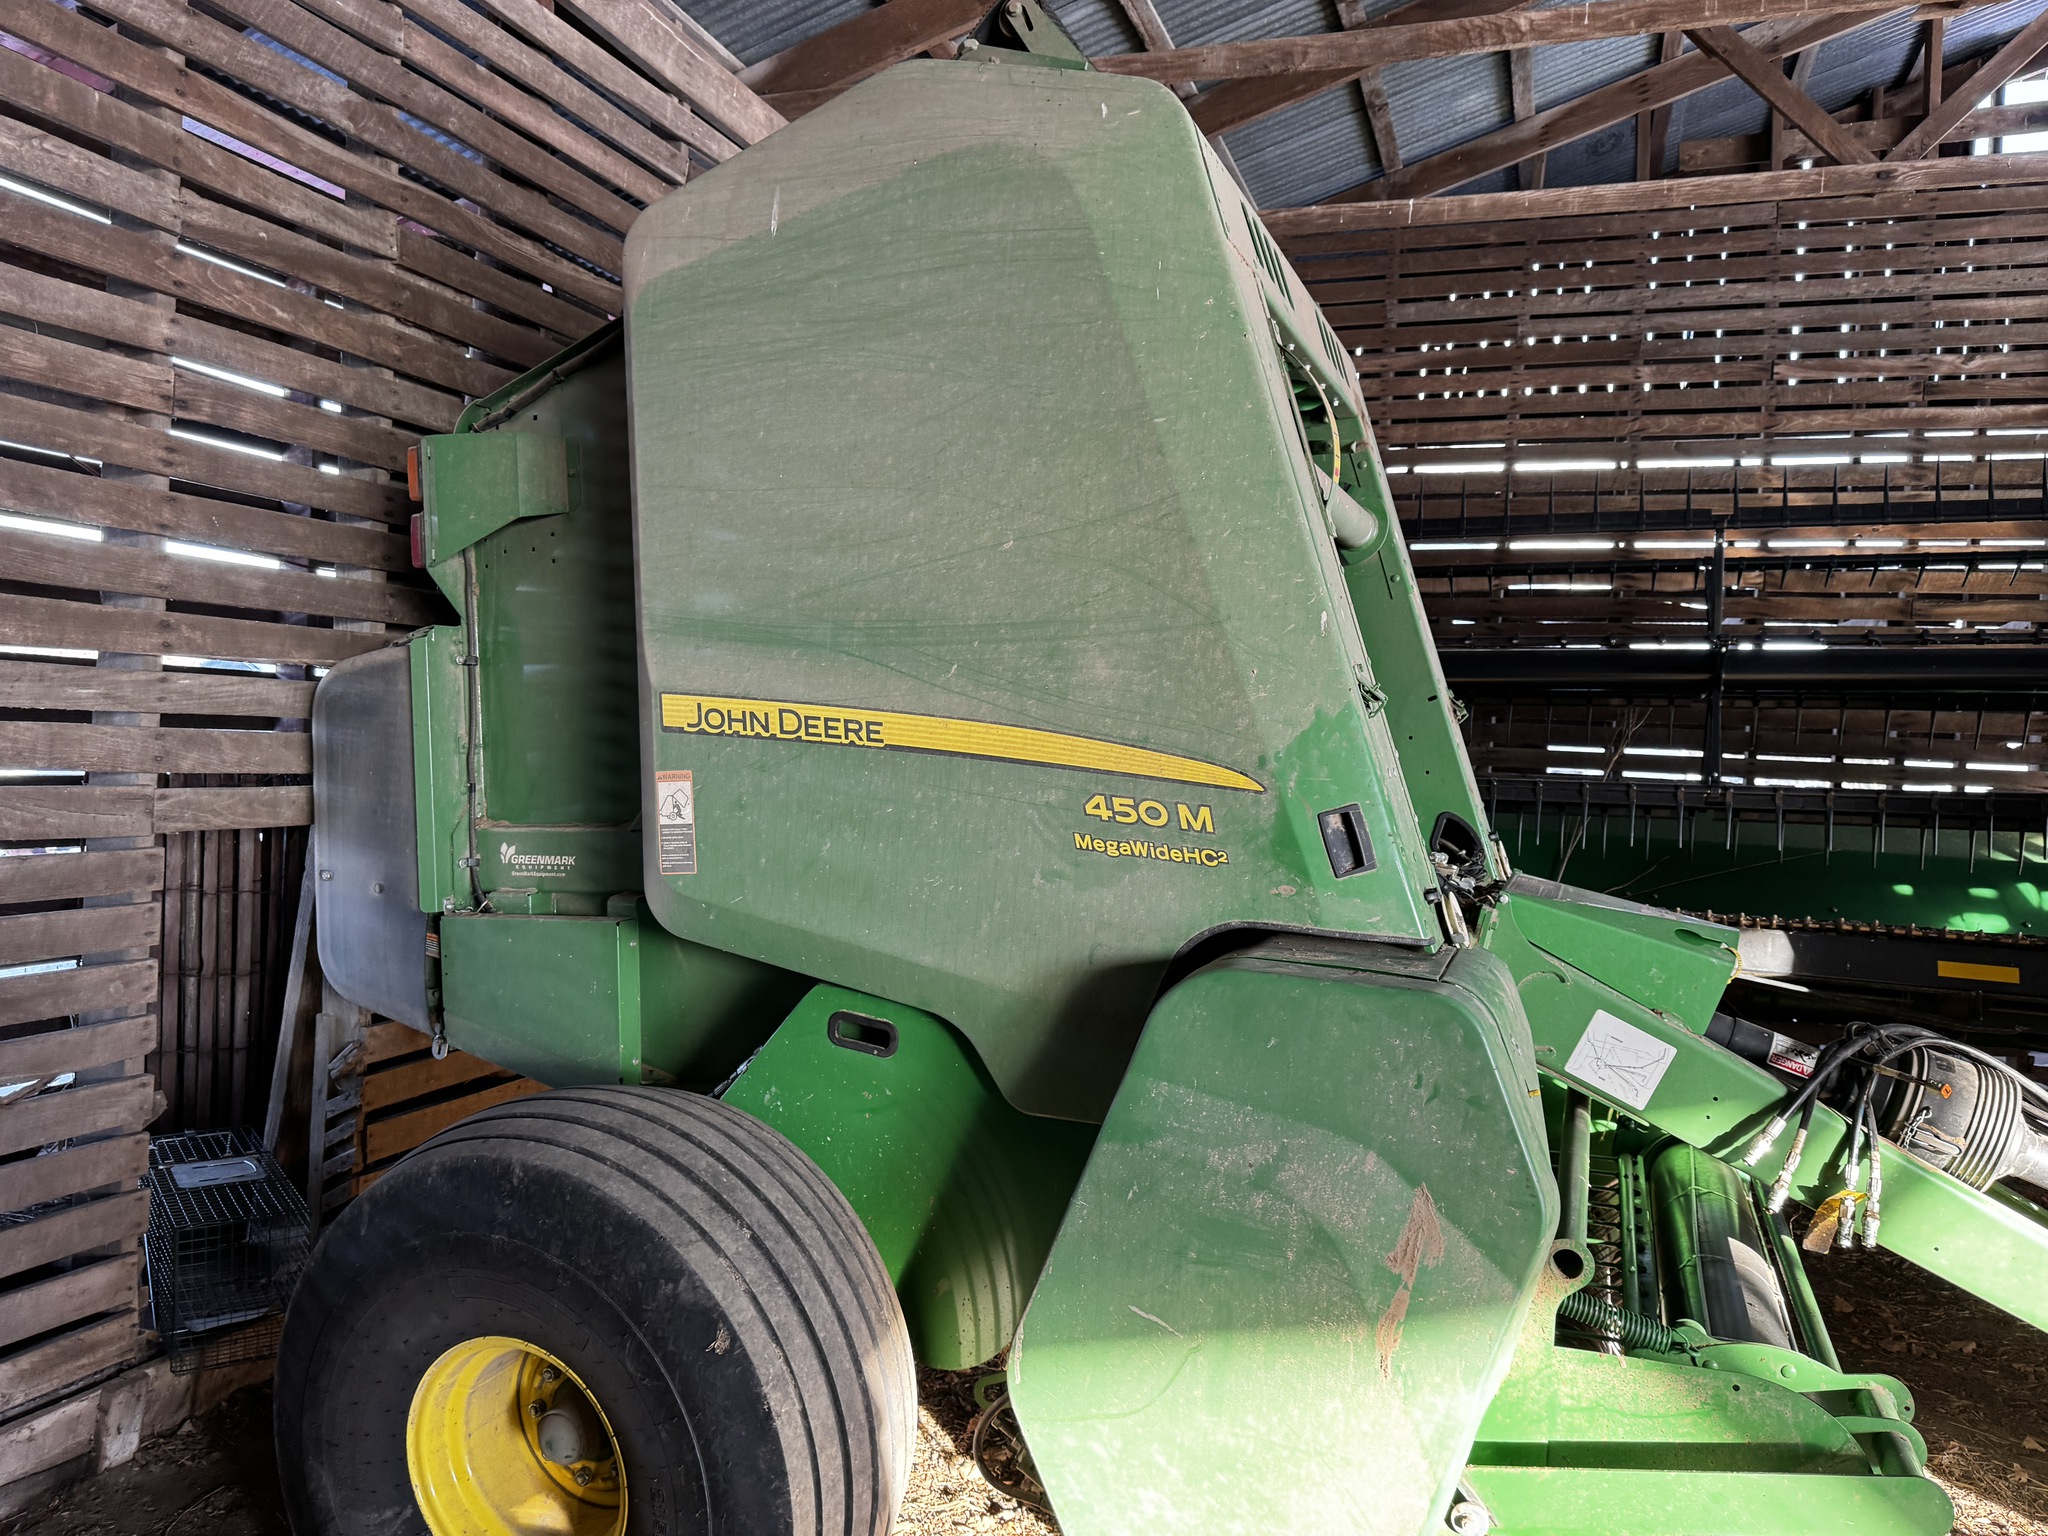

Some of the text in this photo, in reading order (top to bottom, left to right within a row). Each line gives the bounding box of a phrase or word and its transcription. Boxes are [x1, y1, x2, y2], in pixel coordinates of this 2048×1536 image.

[686, 702, 885, 744] JOHN DEERE
[661, 772, 691, 780] WARNING
[1084, 794, 1215, 833] 450 M
[511, 854, 576, 865] GREENMARK
[1771, 1054, 1804, 1073] DANGER
